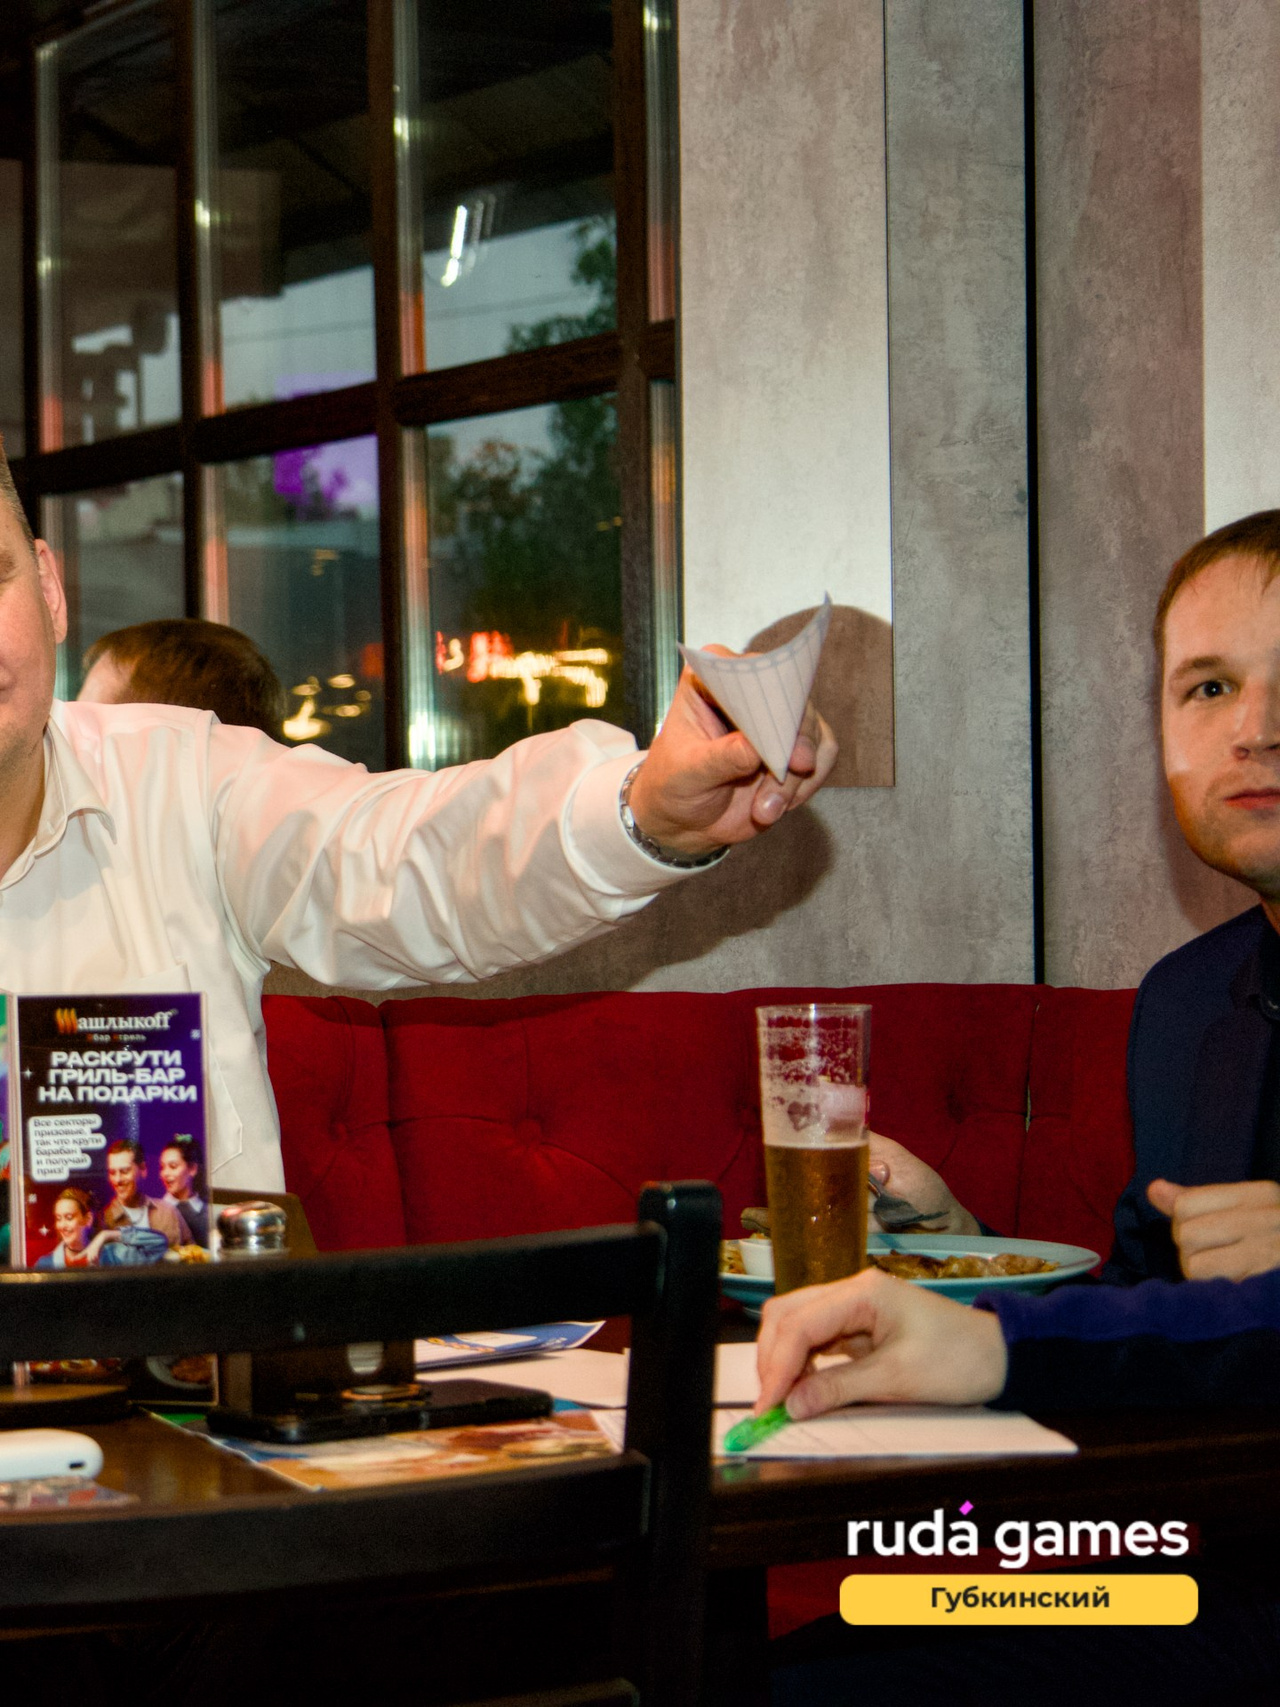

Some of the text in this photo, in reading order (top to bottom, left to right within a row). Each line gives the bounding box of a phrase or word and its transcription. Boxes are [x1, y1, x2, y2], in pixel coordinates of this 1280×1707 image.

[51, 1050, 182, 1067] РАСКРУТИ
[49, 1067, 186, 1085] ГРИЛЬ-БАР
[39, 1085, 198, 1104] НА ПОДАРКИ
[33, 1118, 97, 1128] Все секторы
[72, 1137, 102, 1146] крути
[35, 1147, 77, 1156] барабан
[45, 1155, 88, 1165] получай
[36, 1166, 64, 1176] приз!
